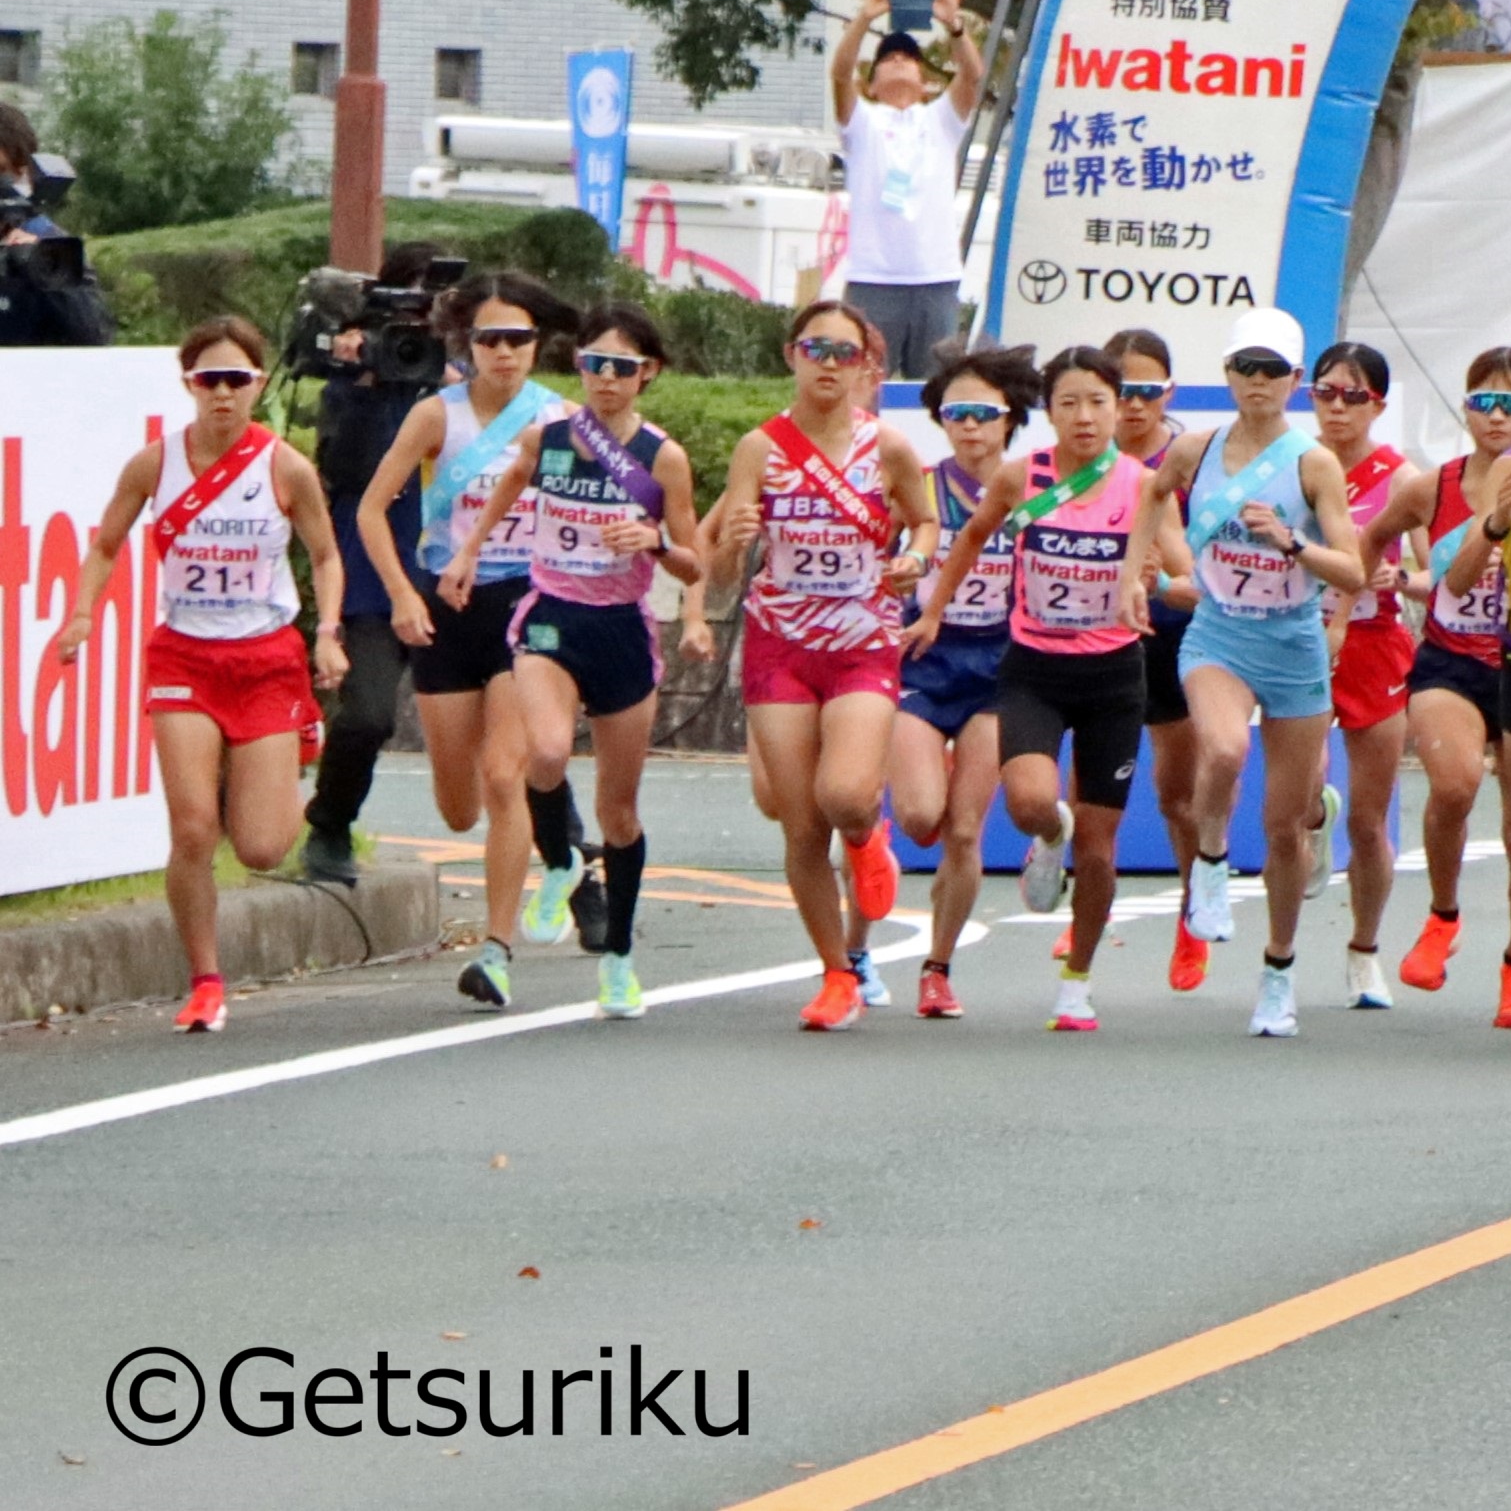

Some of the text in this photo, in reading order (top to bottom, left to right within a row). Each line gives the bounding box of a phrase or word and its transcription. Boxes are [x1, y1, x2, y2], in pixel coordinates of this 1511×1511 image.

[1055, 33, 1306, 99] Iwatani
[1049, 109, 1148, 155] 水素で
[1043, 145, 1266, 199] 世界を動かせ。
[1085, 217, 1212, 251] 車両協力
[1076, 268, 1256, 308] TOYOTA
[542, 474, 601, 497] ROUTE
[193, 518, 270, 537] NORITZ
[780, 524, 864, 548] Iwatan
[1038, 533, 1120, 558] てんまや
[793, 549, 864, 578] 29-1
[1031, 555, 1119, 582] Iwatani
[185, 564, 256, 594] 21-1
